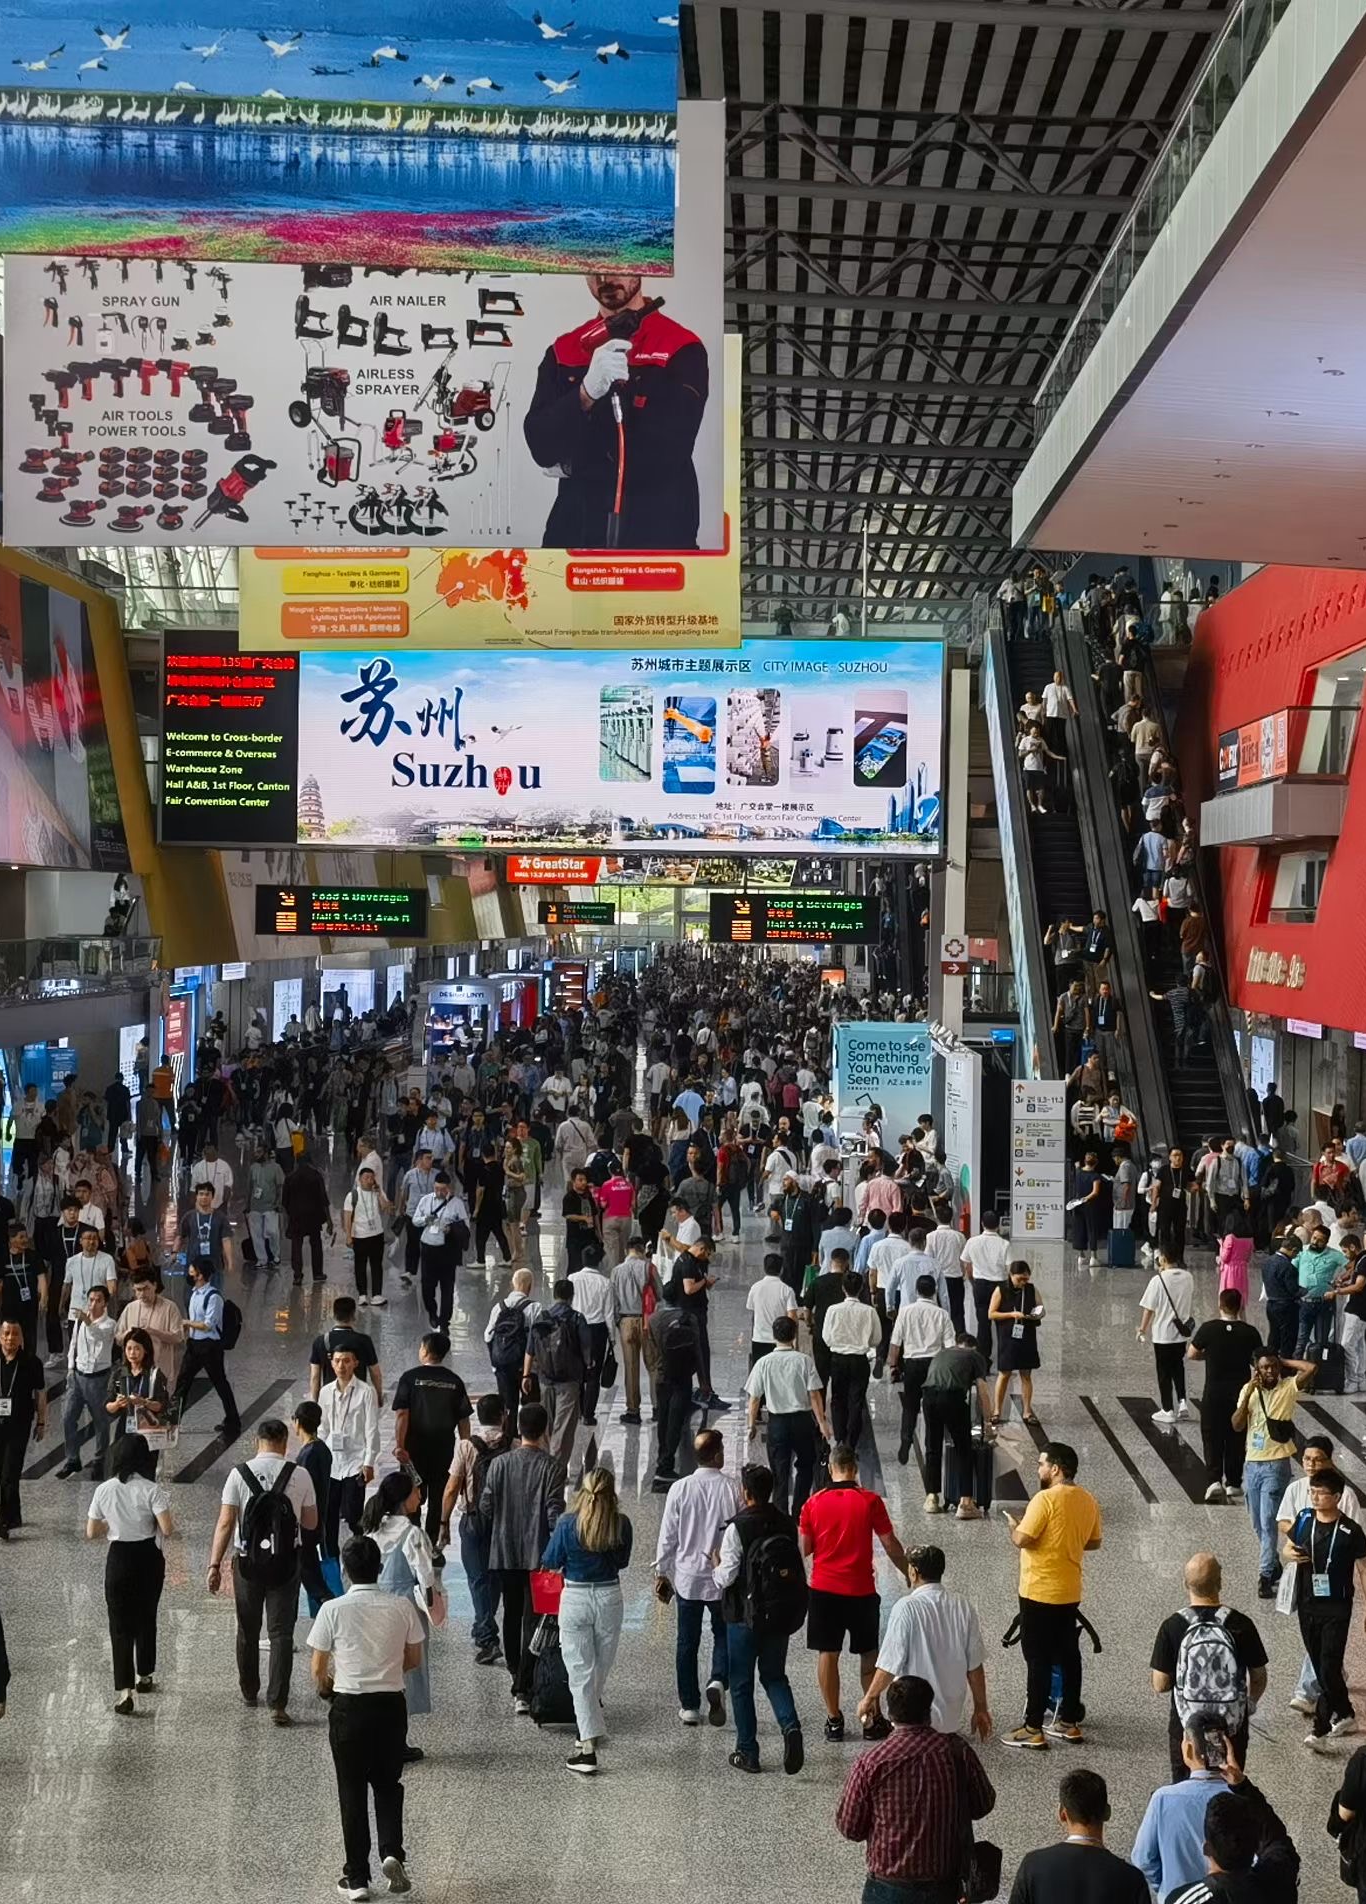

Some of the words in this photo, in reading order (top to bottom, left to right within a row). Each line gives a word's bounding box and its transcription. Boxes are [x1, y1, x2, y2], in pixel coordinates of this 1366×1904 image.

[102, 296, 147, 307] SPRAY
[151, 296, 180, 307] GUN
[369, 295, 393, 306] AIR
[396, 295, 447, 307] NAILER
[356, 368, 415, 380] AIRLESS
[355, 384, 420, 395] SPRAYER
[102, 410, 124, 421] AIR
[128, 410, 173, 421] TOOLS
[88, 426, 138, 437] POWER
[141, 426, 186, 437] TOOLS
[336, 570, 361, 578] Textiles
[613, 615, 720, 626] 国家外贸转型升级基地
[554, 629, 580, 637] Foreign
[666, 629, 700, 638] upgrading
[631, 657, 752, 673] 苏州城市主题展示区
[763, 661, 788, 672] CITY
[791, 661, 829, 673] IMAGE
[838, 662, 887, 673] SUZHOU
[339, 657, 467, 751] 苏州
[166, 732, 209, 741] Welcome
[211, 733, 221, 741] to
[223, 733, 283, 743] Cross-border
[166, 748, 222, 758] E-commerce
[225, 750, 234, 758] &
[235, 750, 277, 758] Overseas
[166, 764, 217, 773] Warehouse
[219, 765, 243, 774] Zone
[166, 780, 183, 789] Hall
[185, 781, 210, 790] A&B,
[212, 781, 226, 790] 1st
[228, 782, 255, 791] Floor,
[257, 782, 290, 791] Canton
[165, 796, 182, 805] Fair
[184, 797, 237, 806] Convention
[239, 797, 270, 807] Center
[668, 812, 698, 820] Address:
[532, 858, 586, 870] GreatStar
[312, 892, 340, 901] Food
[767, 900, 794, 909] Food
[848, 1039, 886, 1051] Come
[889, 1041, 901, 1051] to
[903, 1043, 926, 1051] see
[848, 1051, 919, 1065] Something
[848, 1062, 871, 1074] You
[874, 1063, 905, 1074] have
[848, 1074, 879, 1085] Seen
